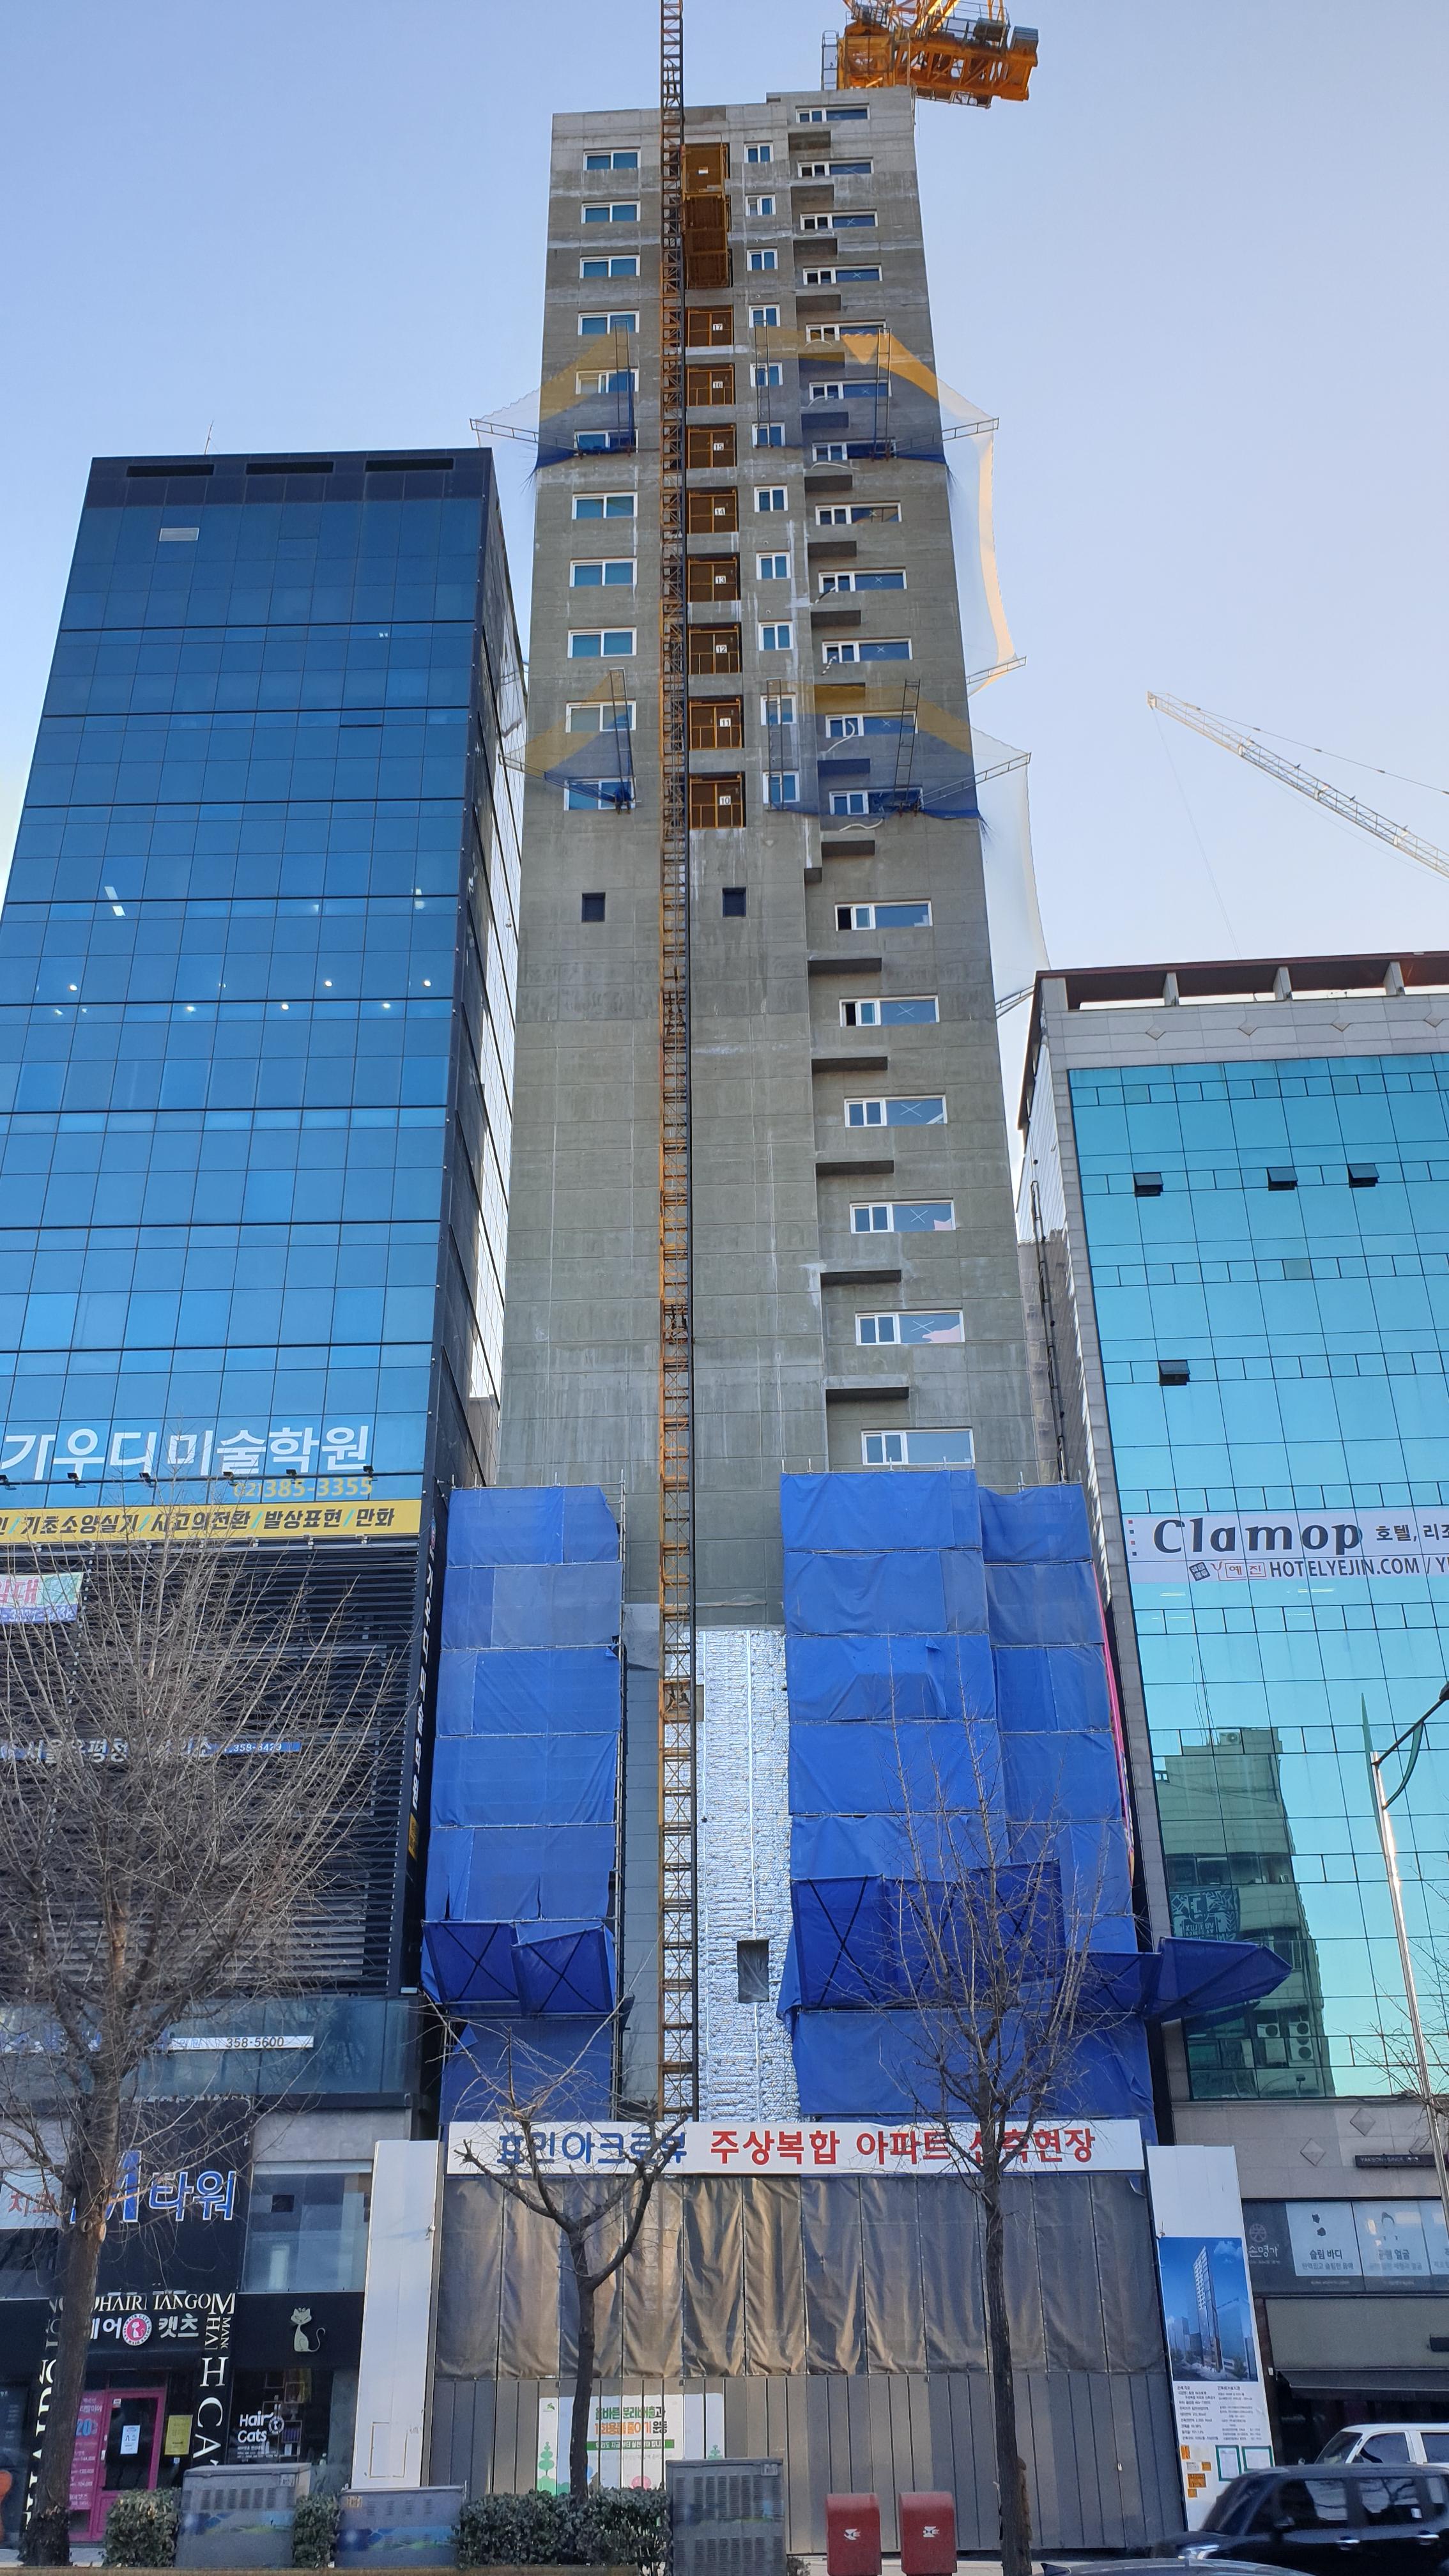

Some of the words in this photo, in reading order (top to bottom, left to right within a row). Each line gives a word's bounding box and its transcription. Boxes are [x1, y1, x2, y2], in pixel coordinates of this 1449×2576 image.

[1, 1425, 369, 1481] 가우디미술학원
[20, 1514, 139, 1534] 기초소양실기
[264, 1509, 342, 1529] 발상표현
[356, 1508, 394, 1527] 만화
[1154, 1517, 1363, 1556] Clamop
[1376, 1524, 1417, 1542] 호텔,
[1229, 1565, 1262, 1575] 예진
[1269, 1558, 1420, 1577] HOTELYEJIN.COM
[710, 2130, 840, 2165] 주상복합
[856, 2131, 951, 2165] 아파트
[1327, 2249, 1342, 2260] 바디
[158, 2313, 199, 2338] 캣츠
[239, 2411, 274, 2427] Hair
[238, 2429, 267, 2443] Cats
